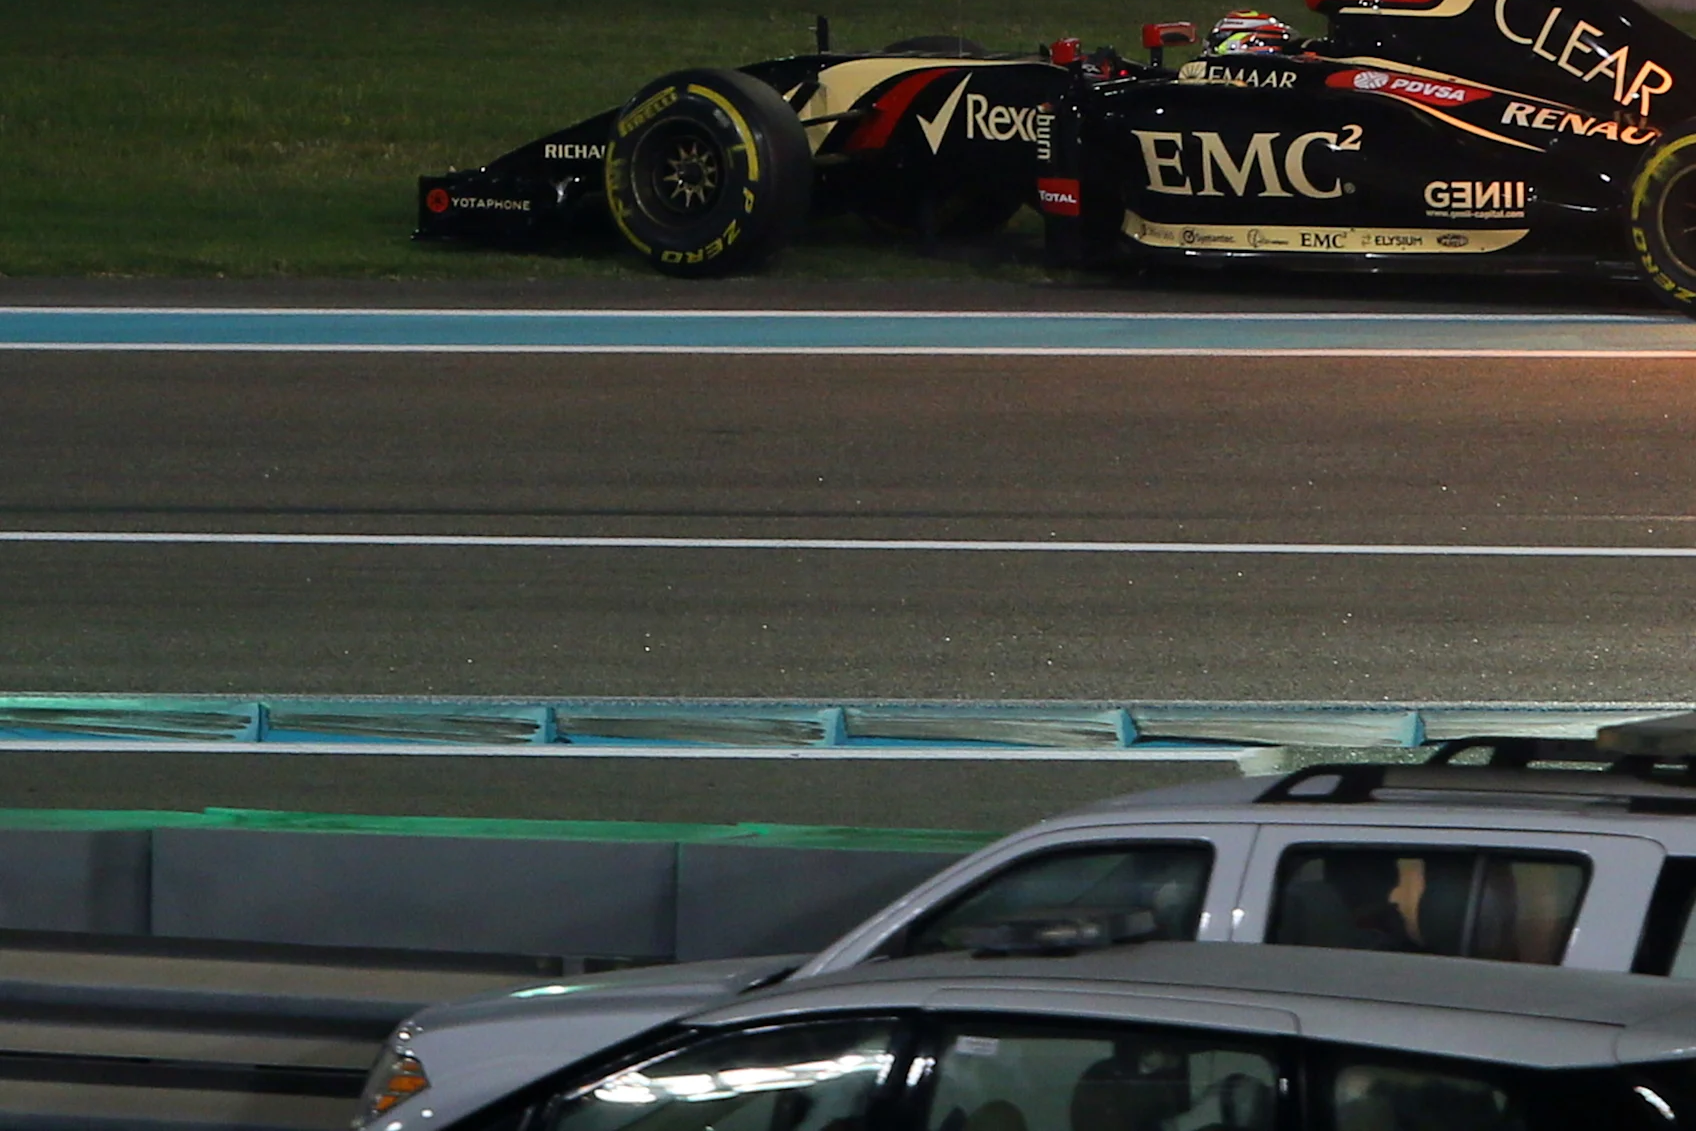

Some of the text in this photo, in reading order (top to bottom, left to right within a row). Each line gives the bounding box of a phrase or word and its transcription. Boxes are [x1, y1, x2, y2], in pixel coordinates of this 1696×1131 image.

[1208, 66, 1297, 88] EMAAR
[1390, 77, 1467, 102] PDVSA
[1036, 115, 1056, 160] burn
[451, 197, 531, 211] YOTAPHONE
[1038, 190, 1077, 204] TOTAL
[1424, 180, 1525, 209] GENII
[661, 186, 755, 264] P ZERO
[1425, 210, 1525, 220] www.genii-capital.com
[1375, 235, 1423, 246] ELYSIUM
